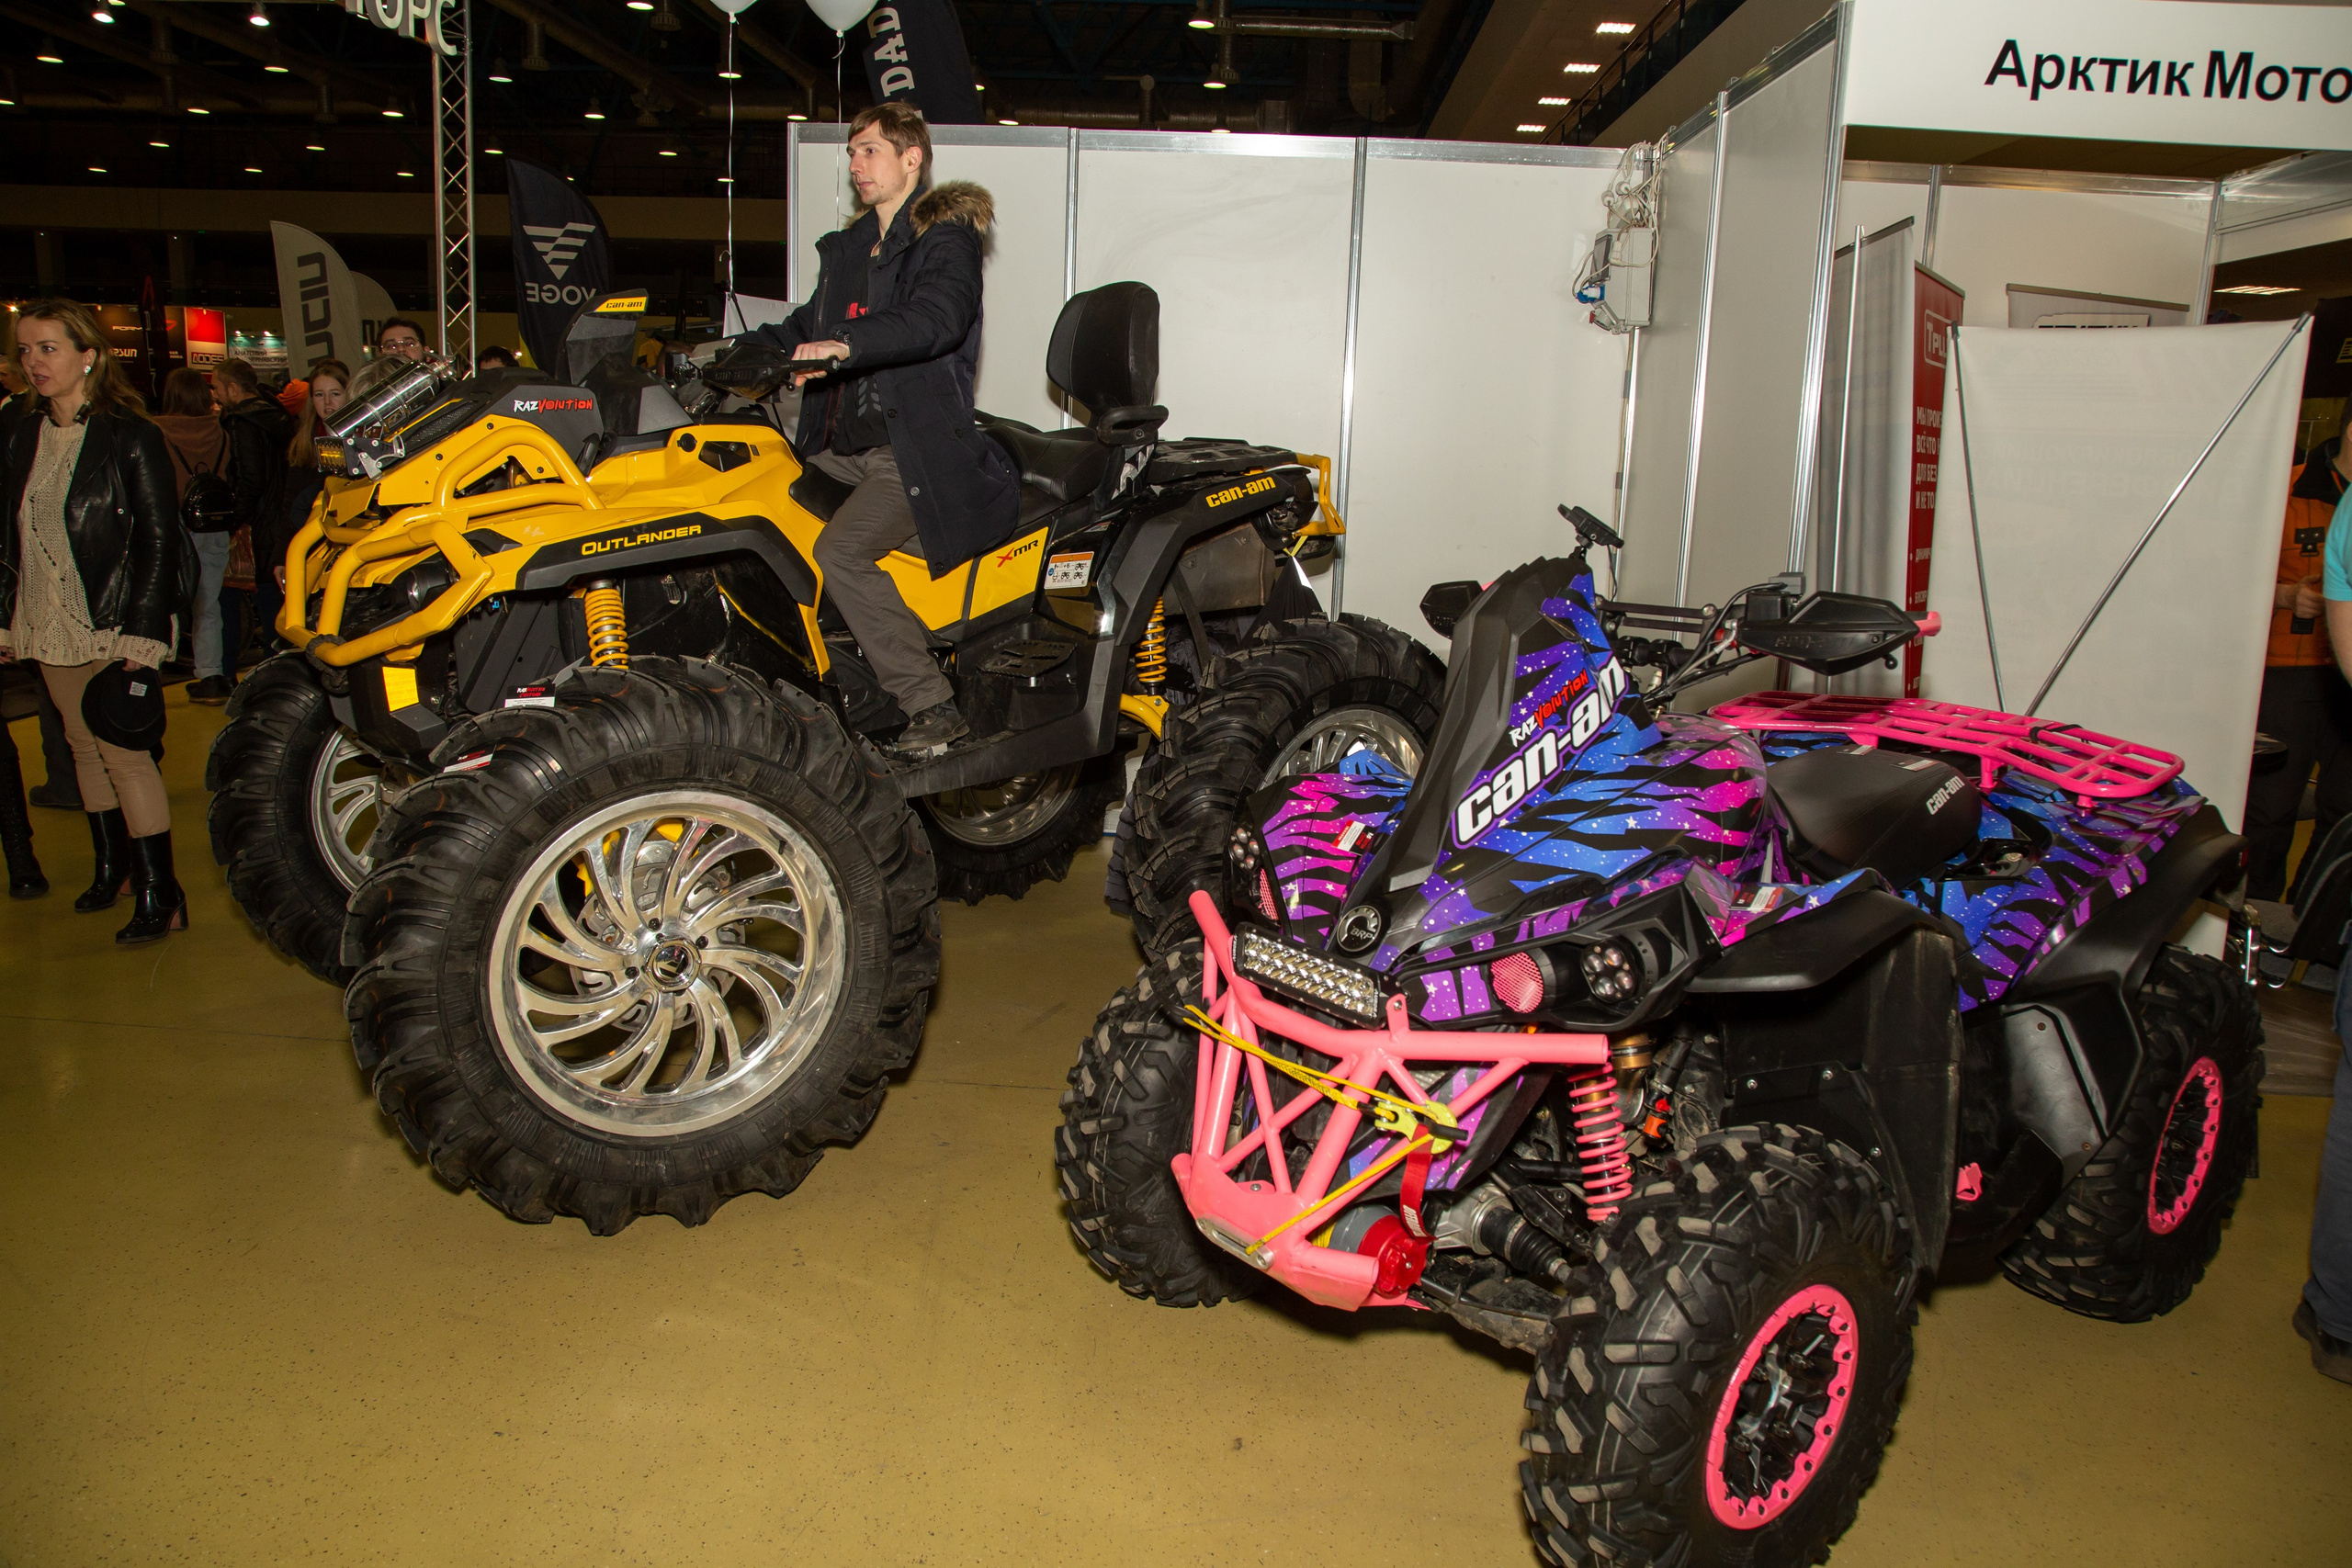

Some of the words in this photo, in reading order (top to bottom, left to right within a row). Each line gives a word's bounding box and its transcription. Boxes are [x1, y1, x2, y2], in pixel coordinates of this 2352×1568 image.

[1984, 39, 2195, 100] Арктик
[2203, 50, 2352, 104] Мото
[605, 300, 643, 309] can-am
[1205, 477, 1276, 508] can-am
[581, 525, 702, 556] OUTLANDER
[1457, 655, 1626, 842] can-am
[1926, 775, 1965, 816] can-am
[1351, 928, 1374, 940] BRP
